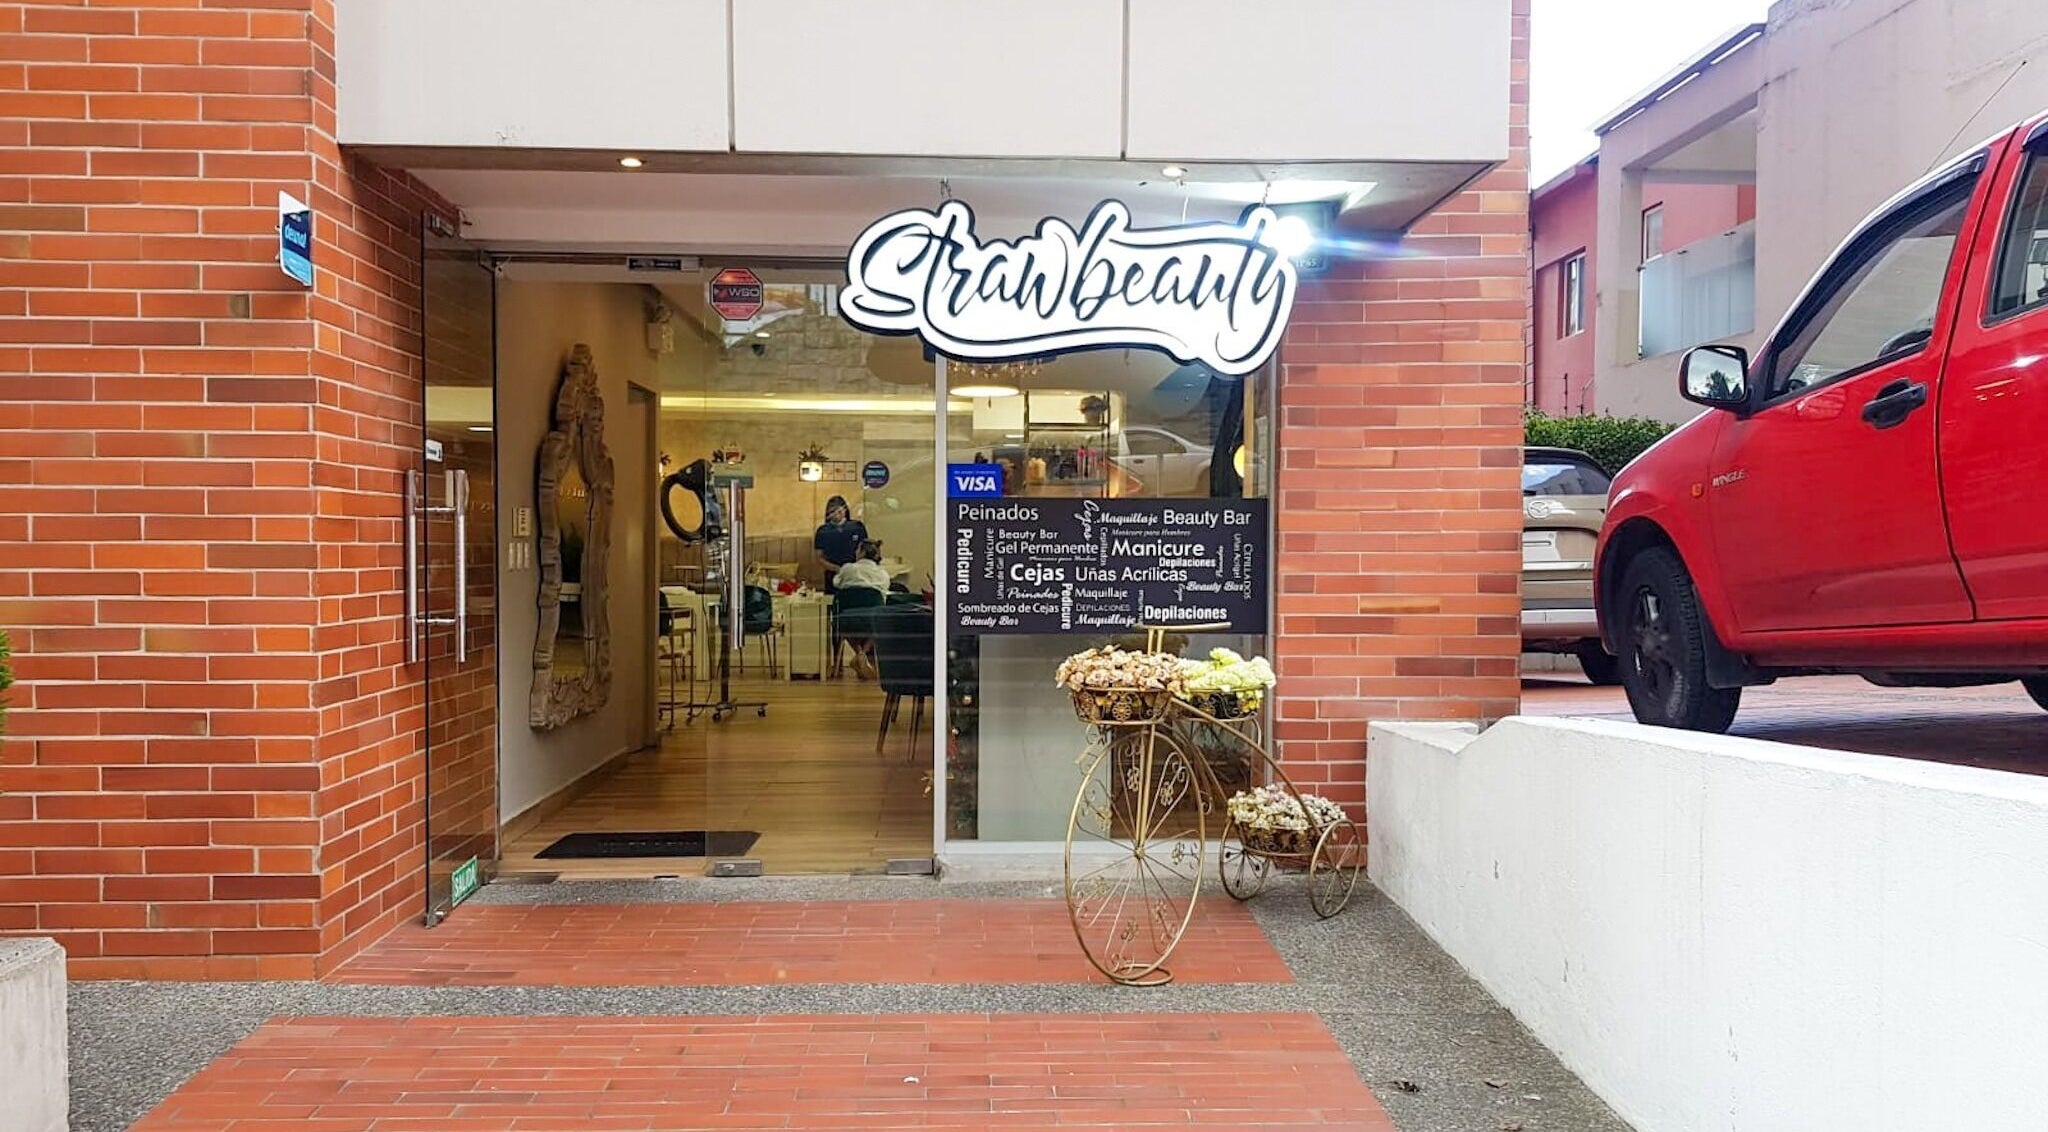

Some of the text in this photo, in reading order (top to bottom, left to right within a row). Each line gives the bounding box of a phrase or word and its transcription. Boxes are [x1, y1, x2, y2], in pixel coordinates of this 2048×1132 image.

[852, 214, 1287, 362] Strawbeauty
[955, 476, 997, 491] VISA
[958, 503, 1040, 520] Peinados
[1163, 509, 1252, 529] Beauty Bar
[1094, 513, 1159, 526] Maquillaje
[998, 529, 1059, 541] Beauty Bar
[984, 527, 995, 579] Manicure
[995, 541, 1099, 554] Gel Permanente
[1100, 526, 1109, 567] Cepillados
[1111, 538, 1206, 557] Manicure
[957, 528, 974, 594] Pedicure
[1159, 556, 1217, 569] Depilaciones
[1010, 563, 1065, 586] Cejas
[1075, 566, 1117, 581] Uñas
[1006, 587, 1060, 599] Peinados
[1075, 587, 1128, 601] Maquillaje
[1186, 580, 1244, 593] Beauty Bar
[957, 602, 1060, 615] Sombreado de Cejas
[1061, 583, 1074, 630] Pedicure
[1144, 604, 1228, 622] Depilaciones
[960, 615, 1020, 628] Beauty Bar
[1074, 613, 1137, 628] Maquillaje
[454, 864, 478, 899] SALIDA
